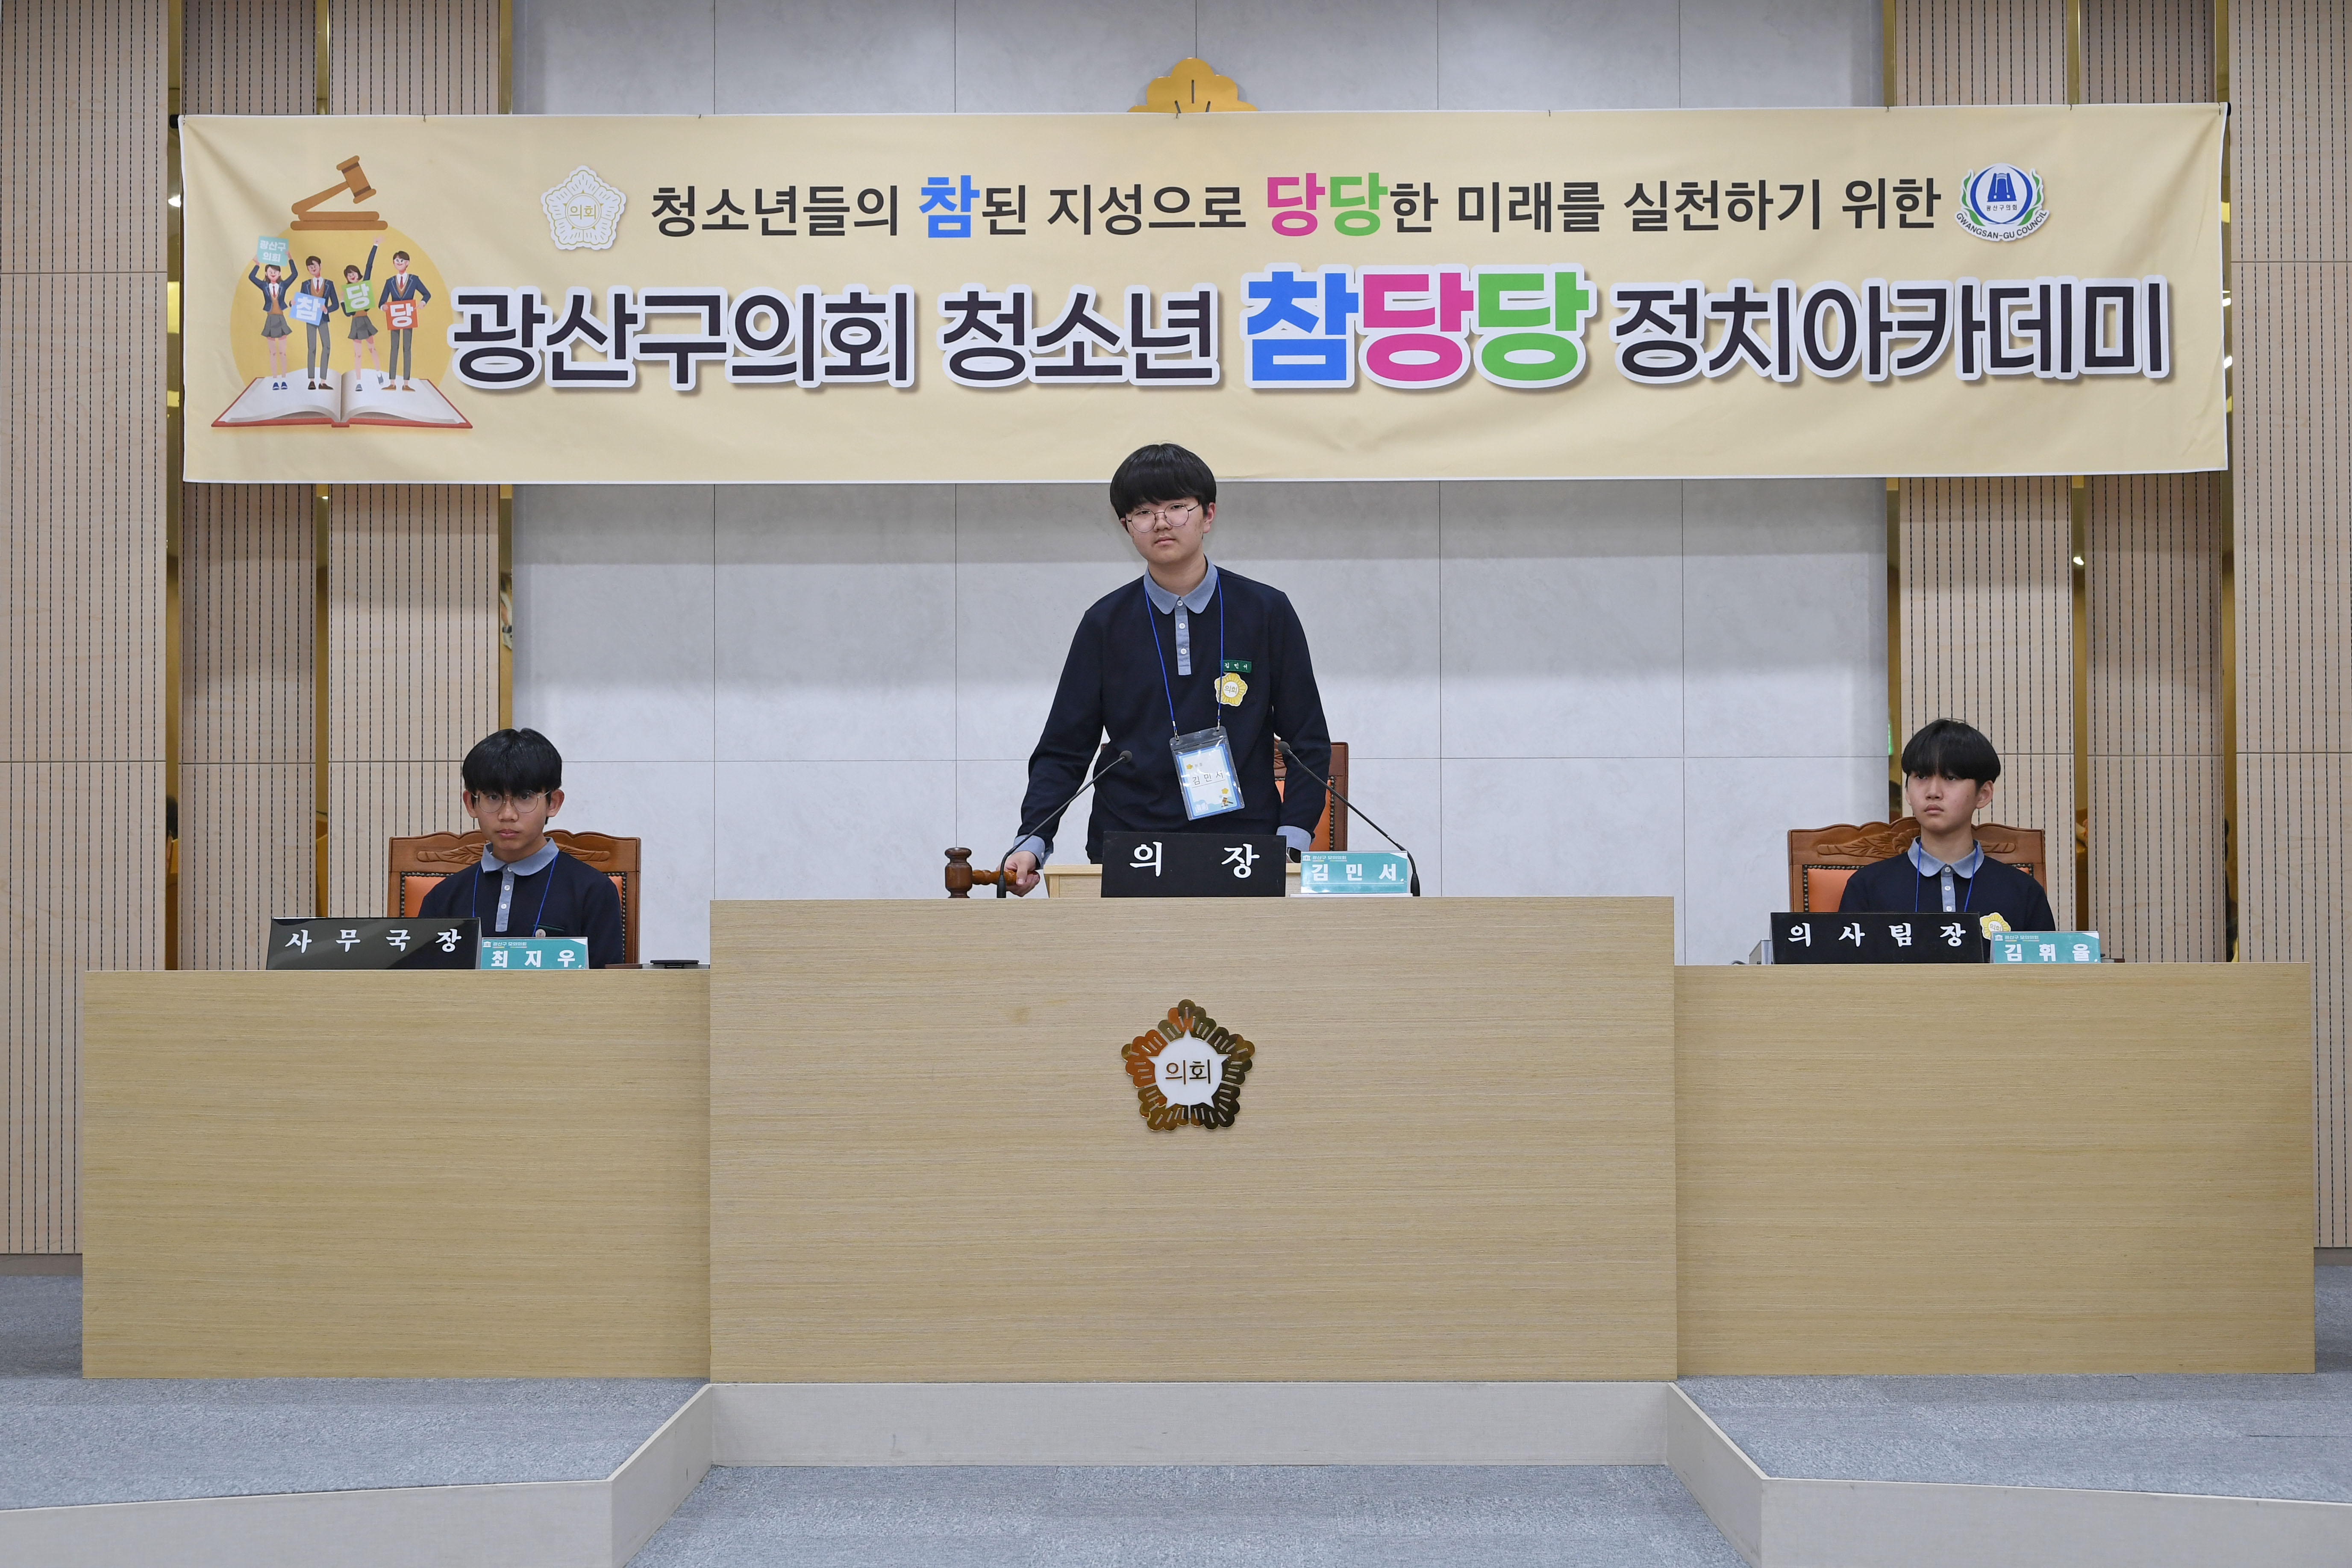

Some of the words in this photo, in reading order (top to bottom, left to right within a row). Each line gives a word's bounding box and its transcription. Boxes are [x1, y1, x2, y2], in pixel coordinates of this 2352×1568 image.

[569, 204, 596, 220] 의회
[651, 185, 898, 238] 청소년들의
[918, 175, 1026, 238] 참된
[1047, 184, 1247, 236] 지성으로
[1267, 172, 1439, 237] 당당한
[1458, 180, 1605, 233] 미래를
[1623, 179, 1820, 233] 실천하기
[1841, 177, 1941, 230] 위한
[1956, 213, 2015, 239] GWANGSAN-GU
[2016, 211, 2047, 236] COUNCIL
[259, 239, 287, 252] 광산구
[263, 252, 281, 263] 의회
[296, 296, 321, 321] 참
[346, 283, 370, 309] 당
[390, 302, 414, 327] 당
[453, 291, 907, 385] 광산구의회
[942, 290, 1214, 381] 청소년
[1246, 271, 1590, 382] 참당당
[1615, 282, 2163, 379] 정치아카데미
[1224, 685, 1238, 694] 의회
[1192, 769, 1223, 785] 김민서
[1165, 1059, 1211, 1085] 의회
